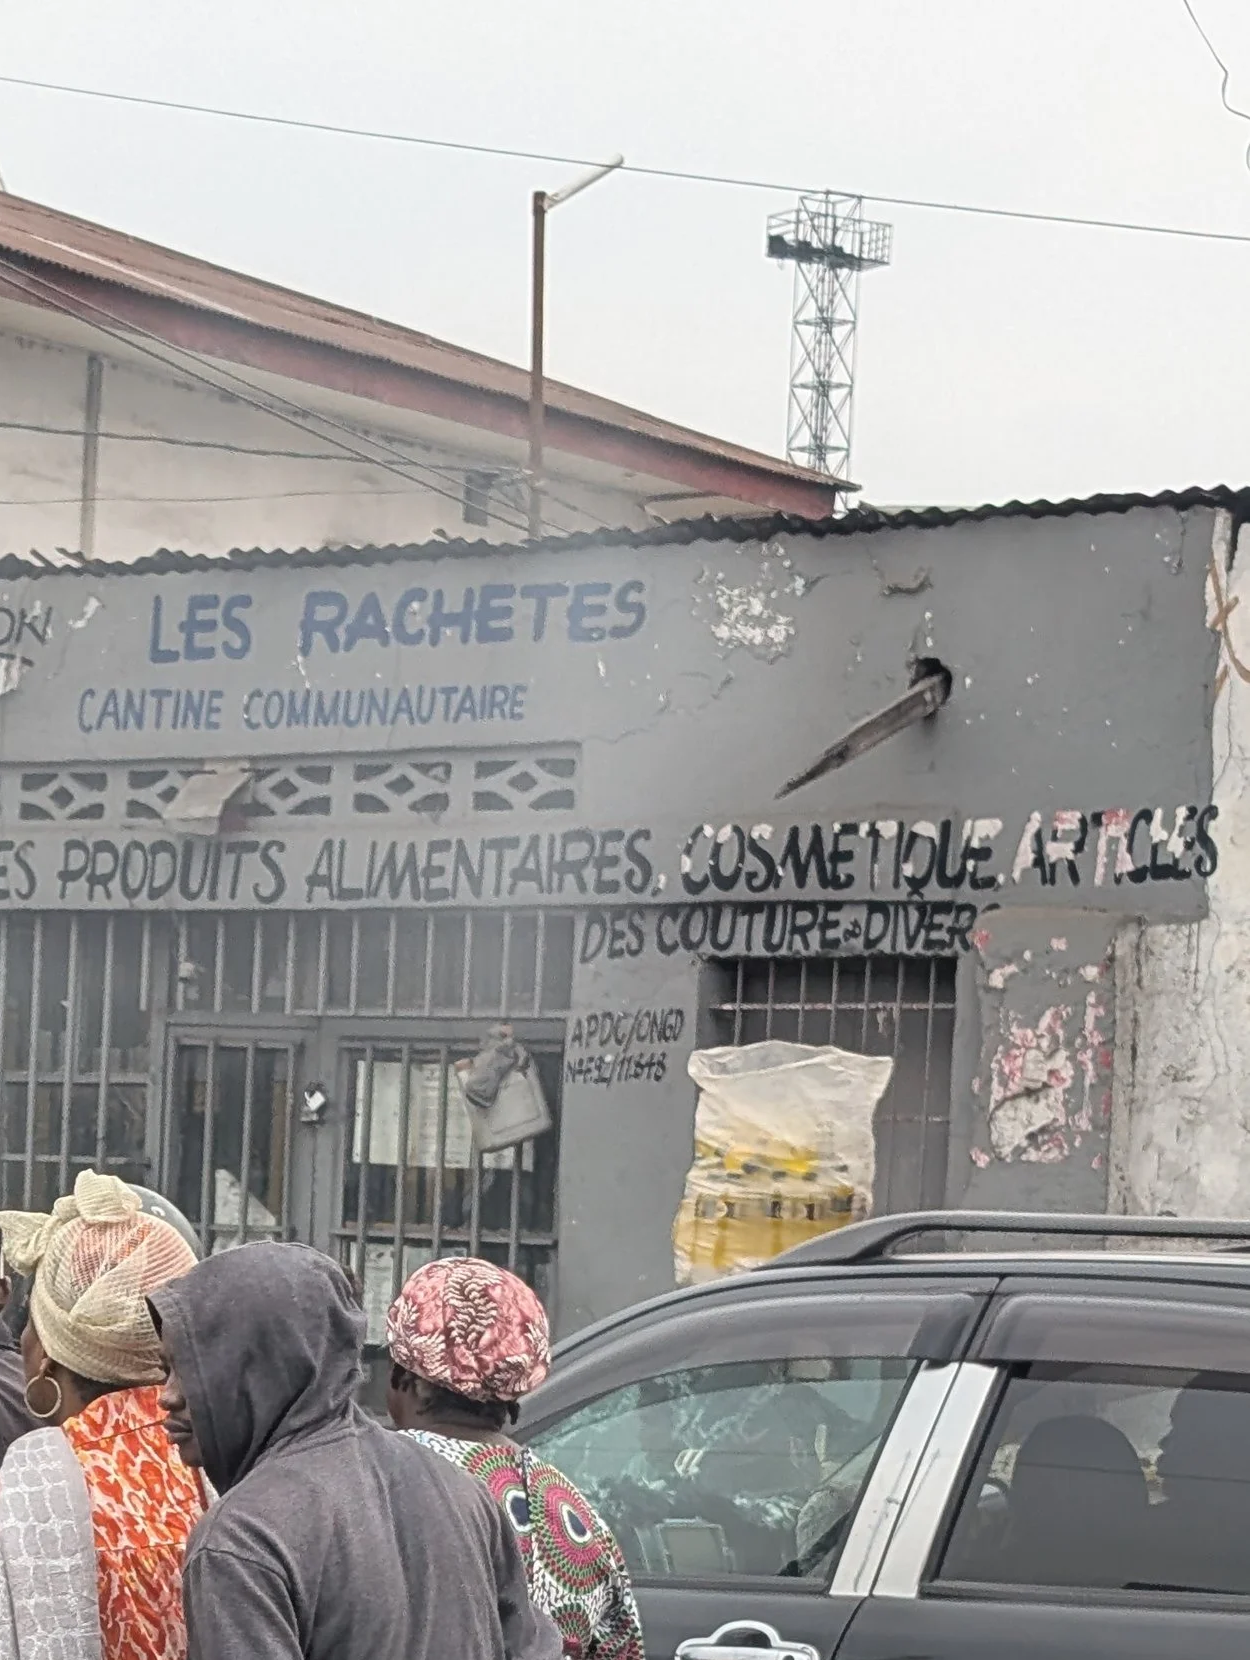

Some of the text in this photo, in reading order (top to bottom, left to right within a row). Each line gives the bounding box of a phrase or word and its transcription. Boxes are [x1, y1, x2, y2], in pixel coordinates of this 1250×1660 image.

[149, 593, 253, 663] LES
[297, 579, 647, 657] RACHETES
[78, 683, 528, 733] CANTINE COMMUNAUTAIRE
[57, 838, 287, 904] PRODUITS
[579, 906, 646, 964] DES
[655, 902, 841, 956] COUTURE
[862, 901, 1002, 952] DIVER
